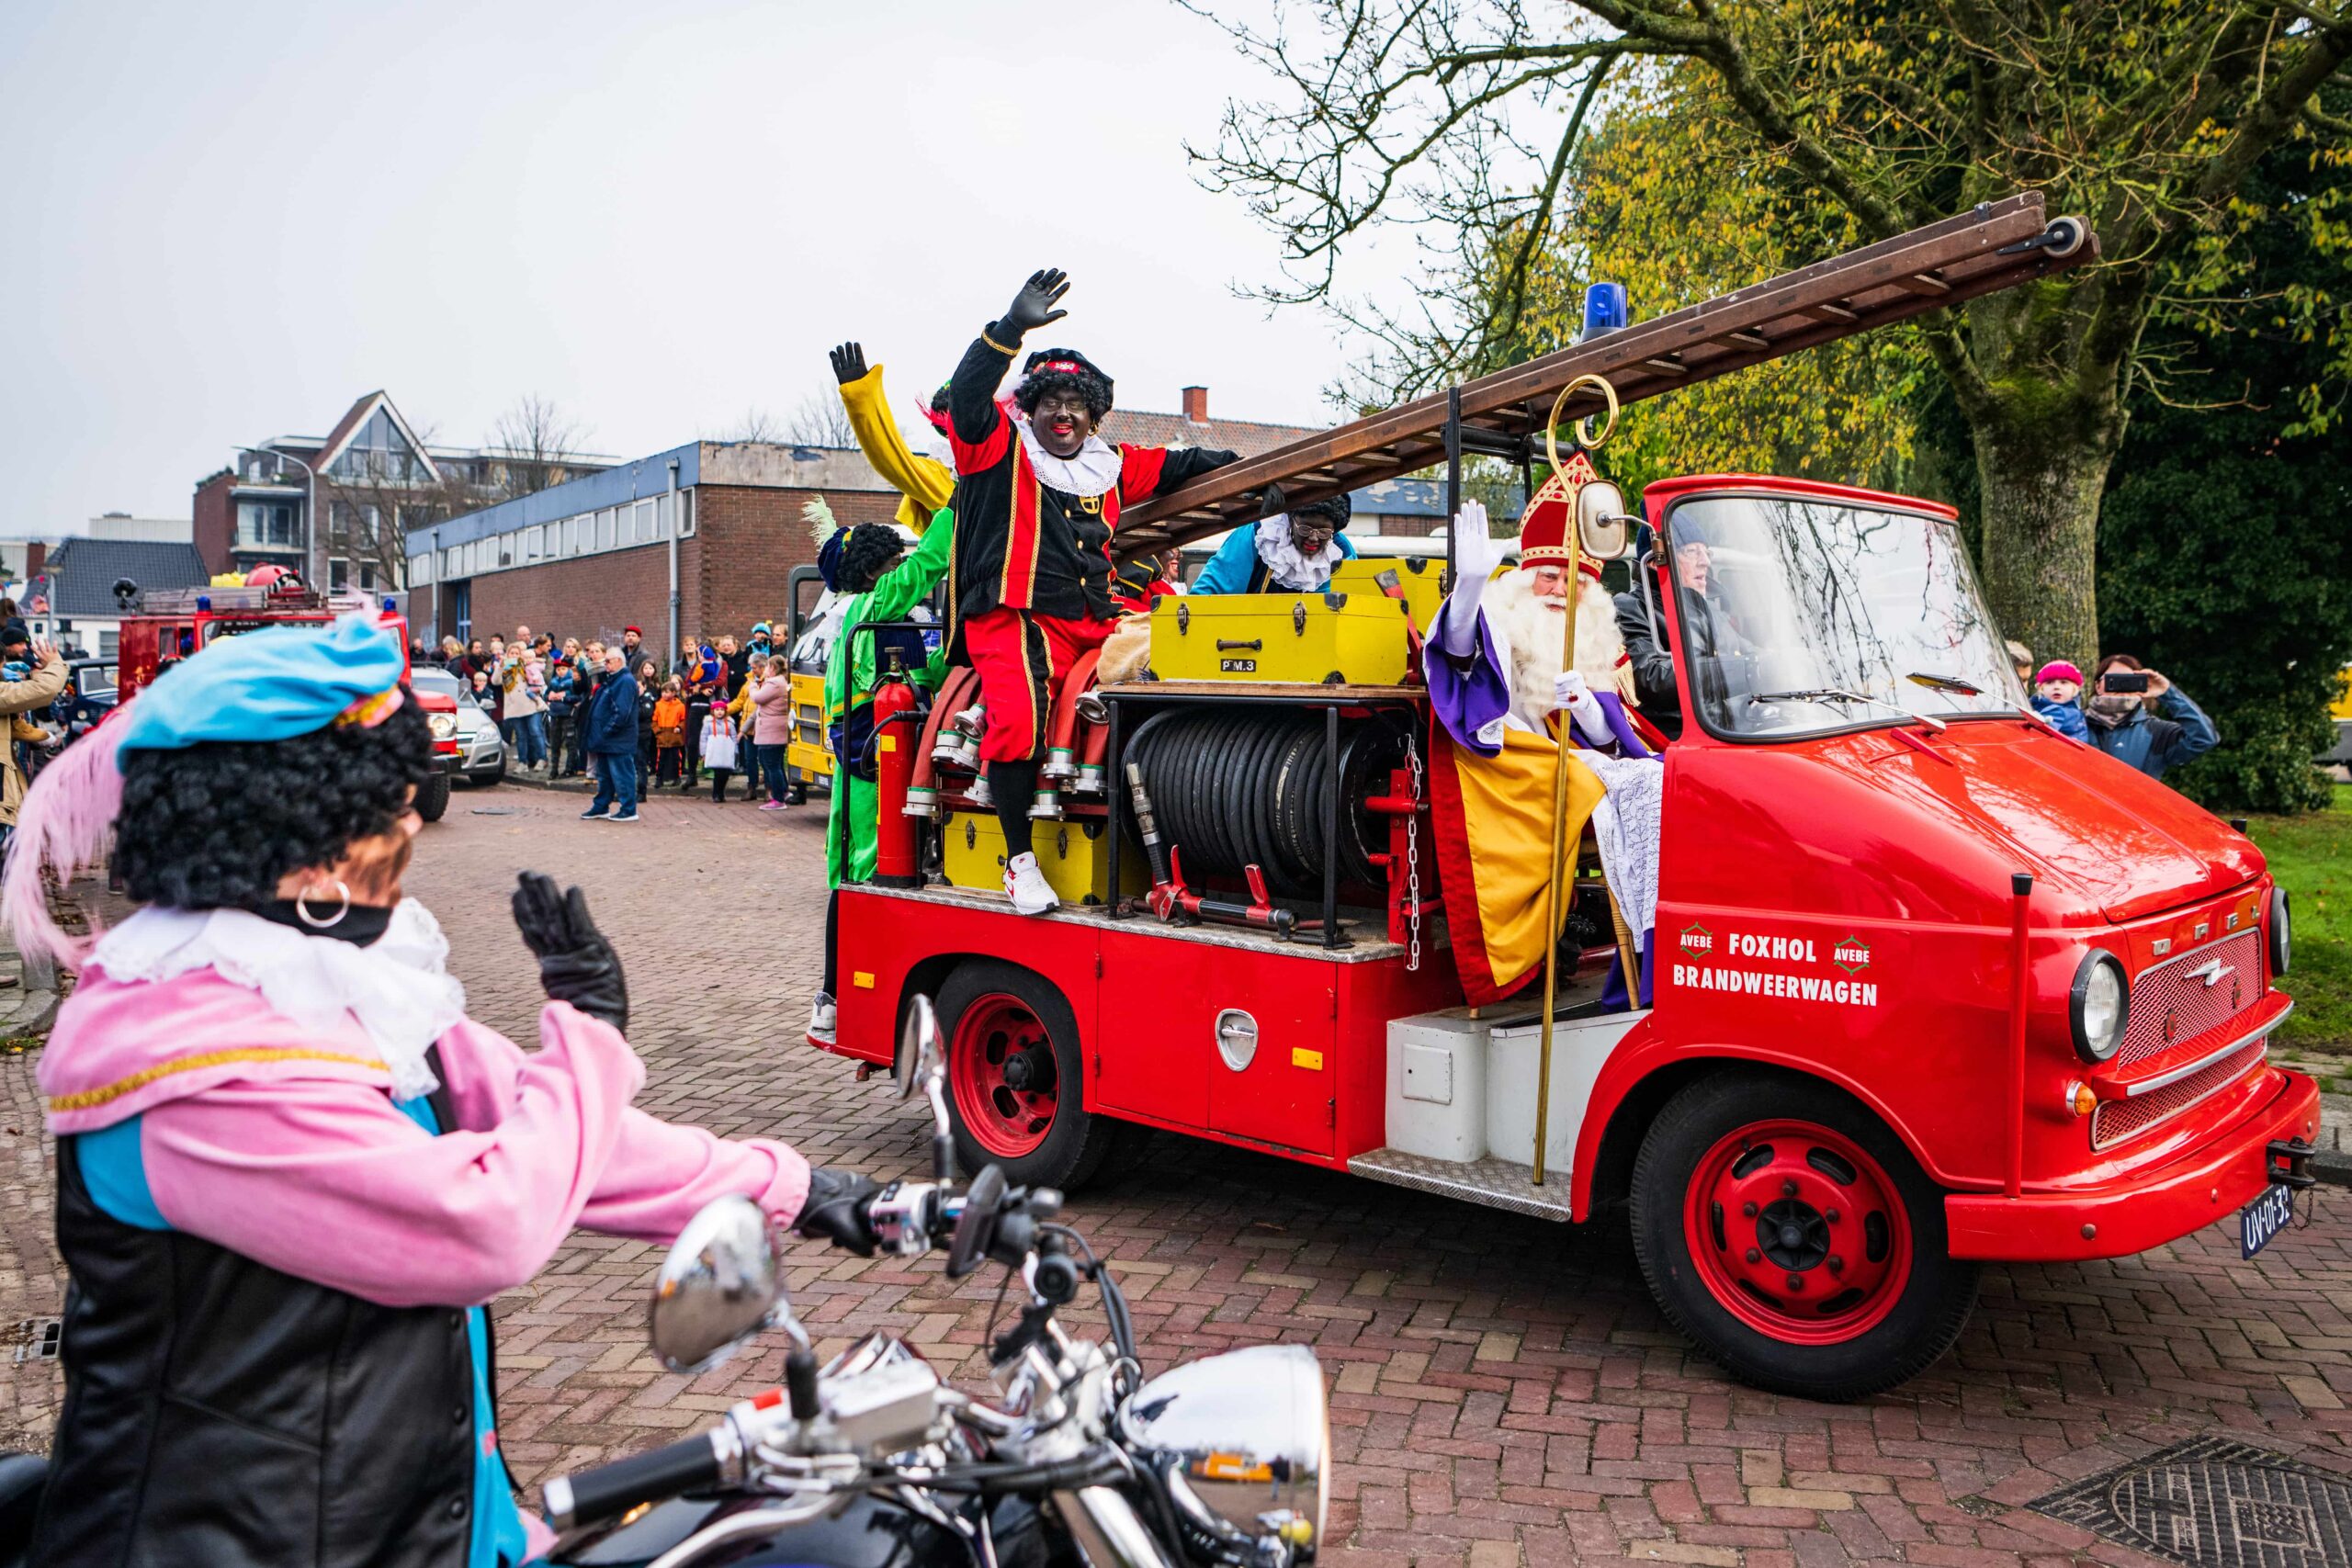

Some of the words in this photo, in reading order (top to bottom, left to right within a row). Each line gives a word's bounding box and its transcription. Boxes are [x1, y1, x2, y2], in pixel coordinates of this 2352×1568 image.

[1679, 933, 1713, 949] AVEBE
[1729, 932, 1816, 963] FOXHOL
[1834, 947, 1870, 964] AVEBE
[2152, 905, 2260, 956] OPEL
[1673, 964, 1877, 1007] BRANDWEERWAGEN
[2245, 1184, 2290, 1250] UV-01-32
